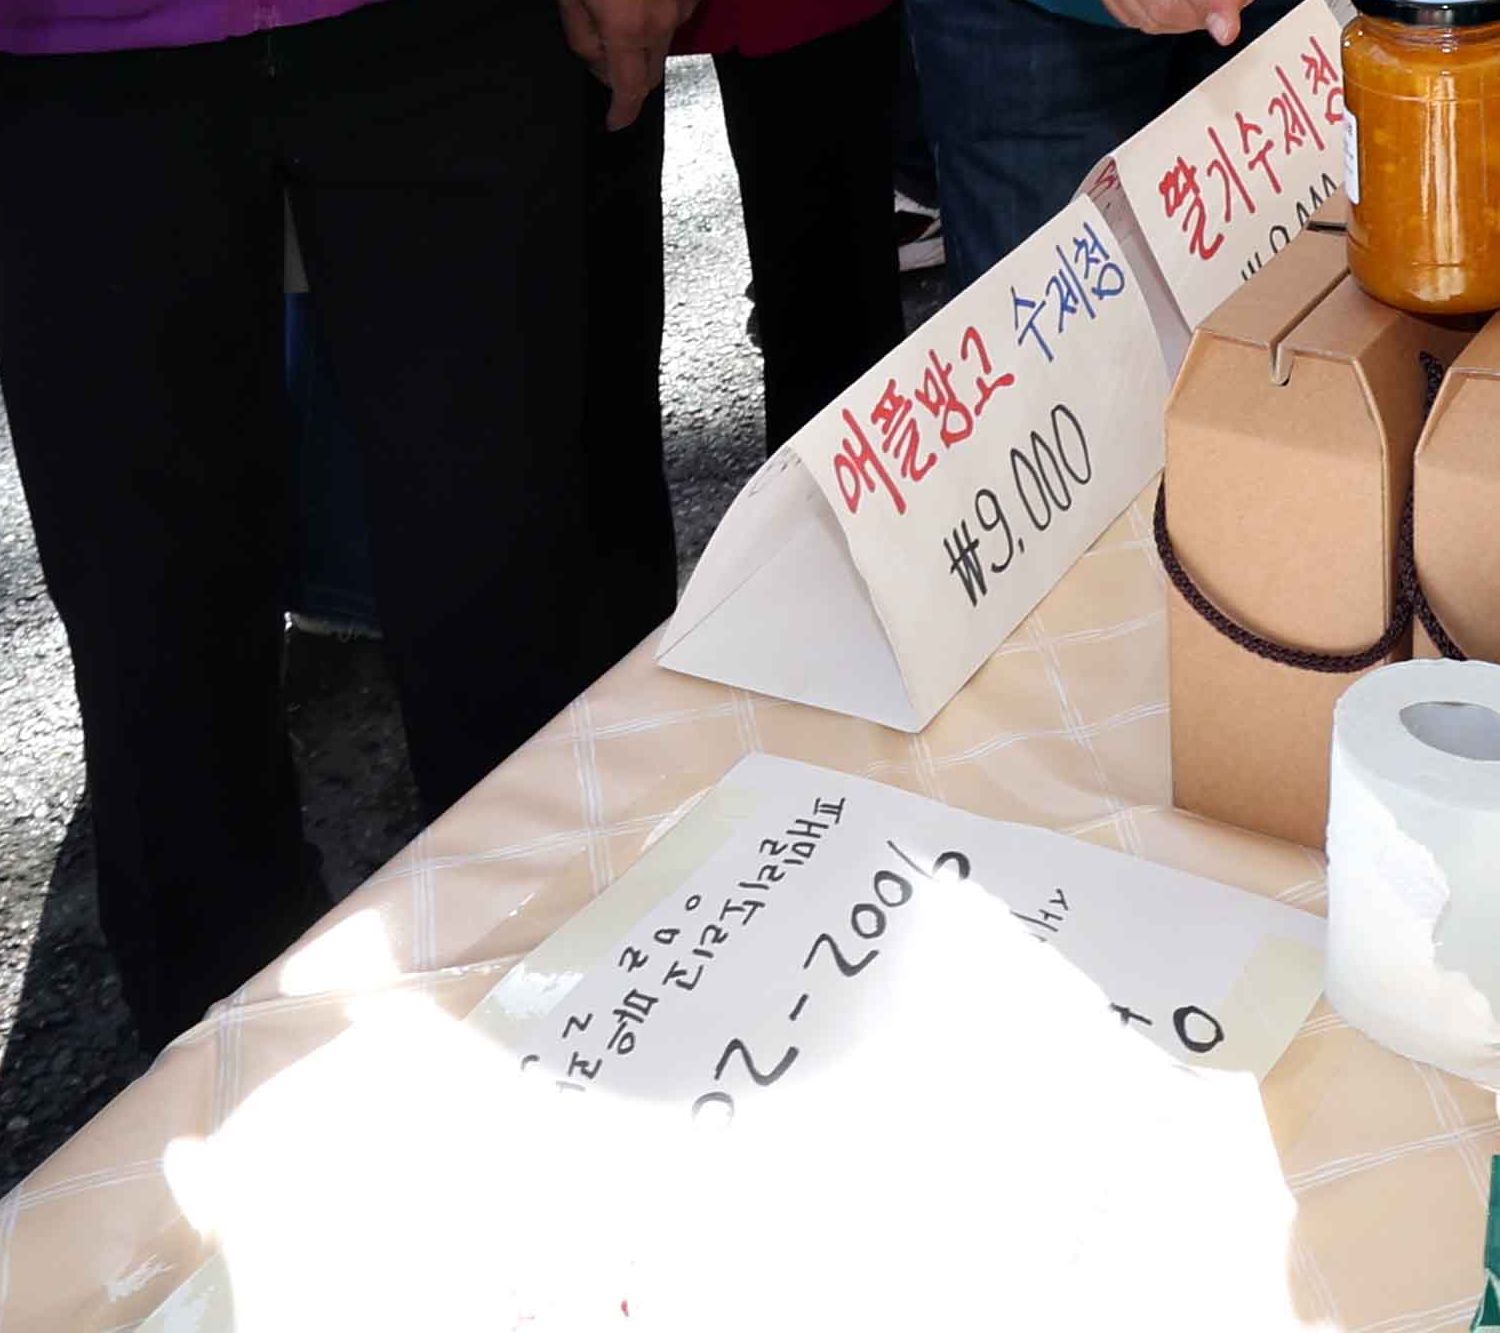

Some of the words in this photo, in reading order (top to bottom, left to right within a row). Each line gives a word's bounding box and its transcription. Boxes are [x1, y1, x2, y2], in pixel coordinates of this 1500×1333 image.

[1158, 35, 1344, 261] 딸기수제청
[833, 325, 1016, 516] 애플망고
[1010, 220, 1126, 364] 수제청
[942, 402, 1093, 609] ₩9,000
